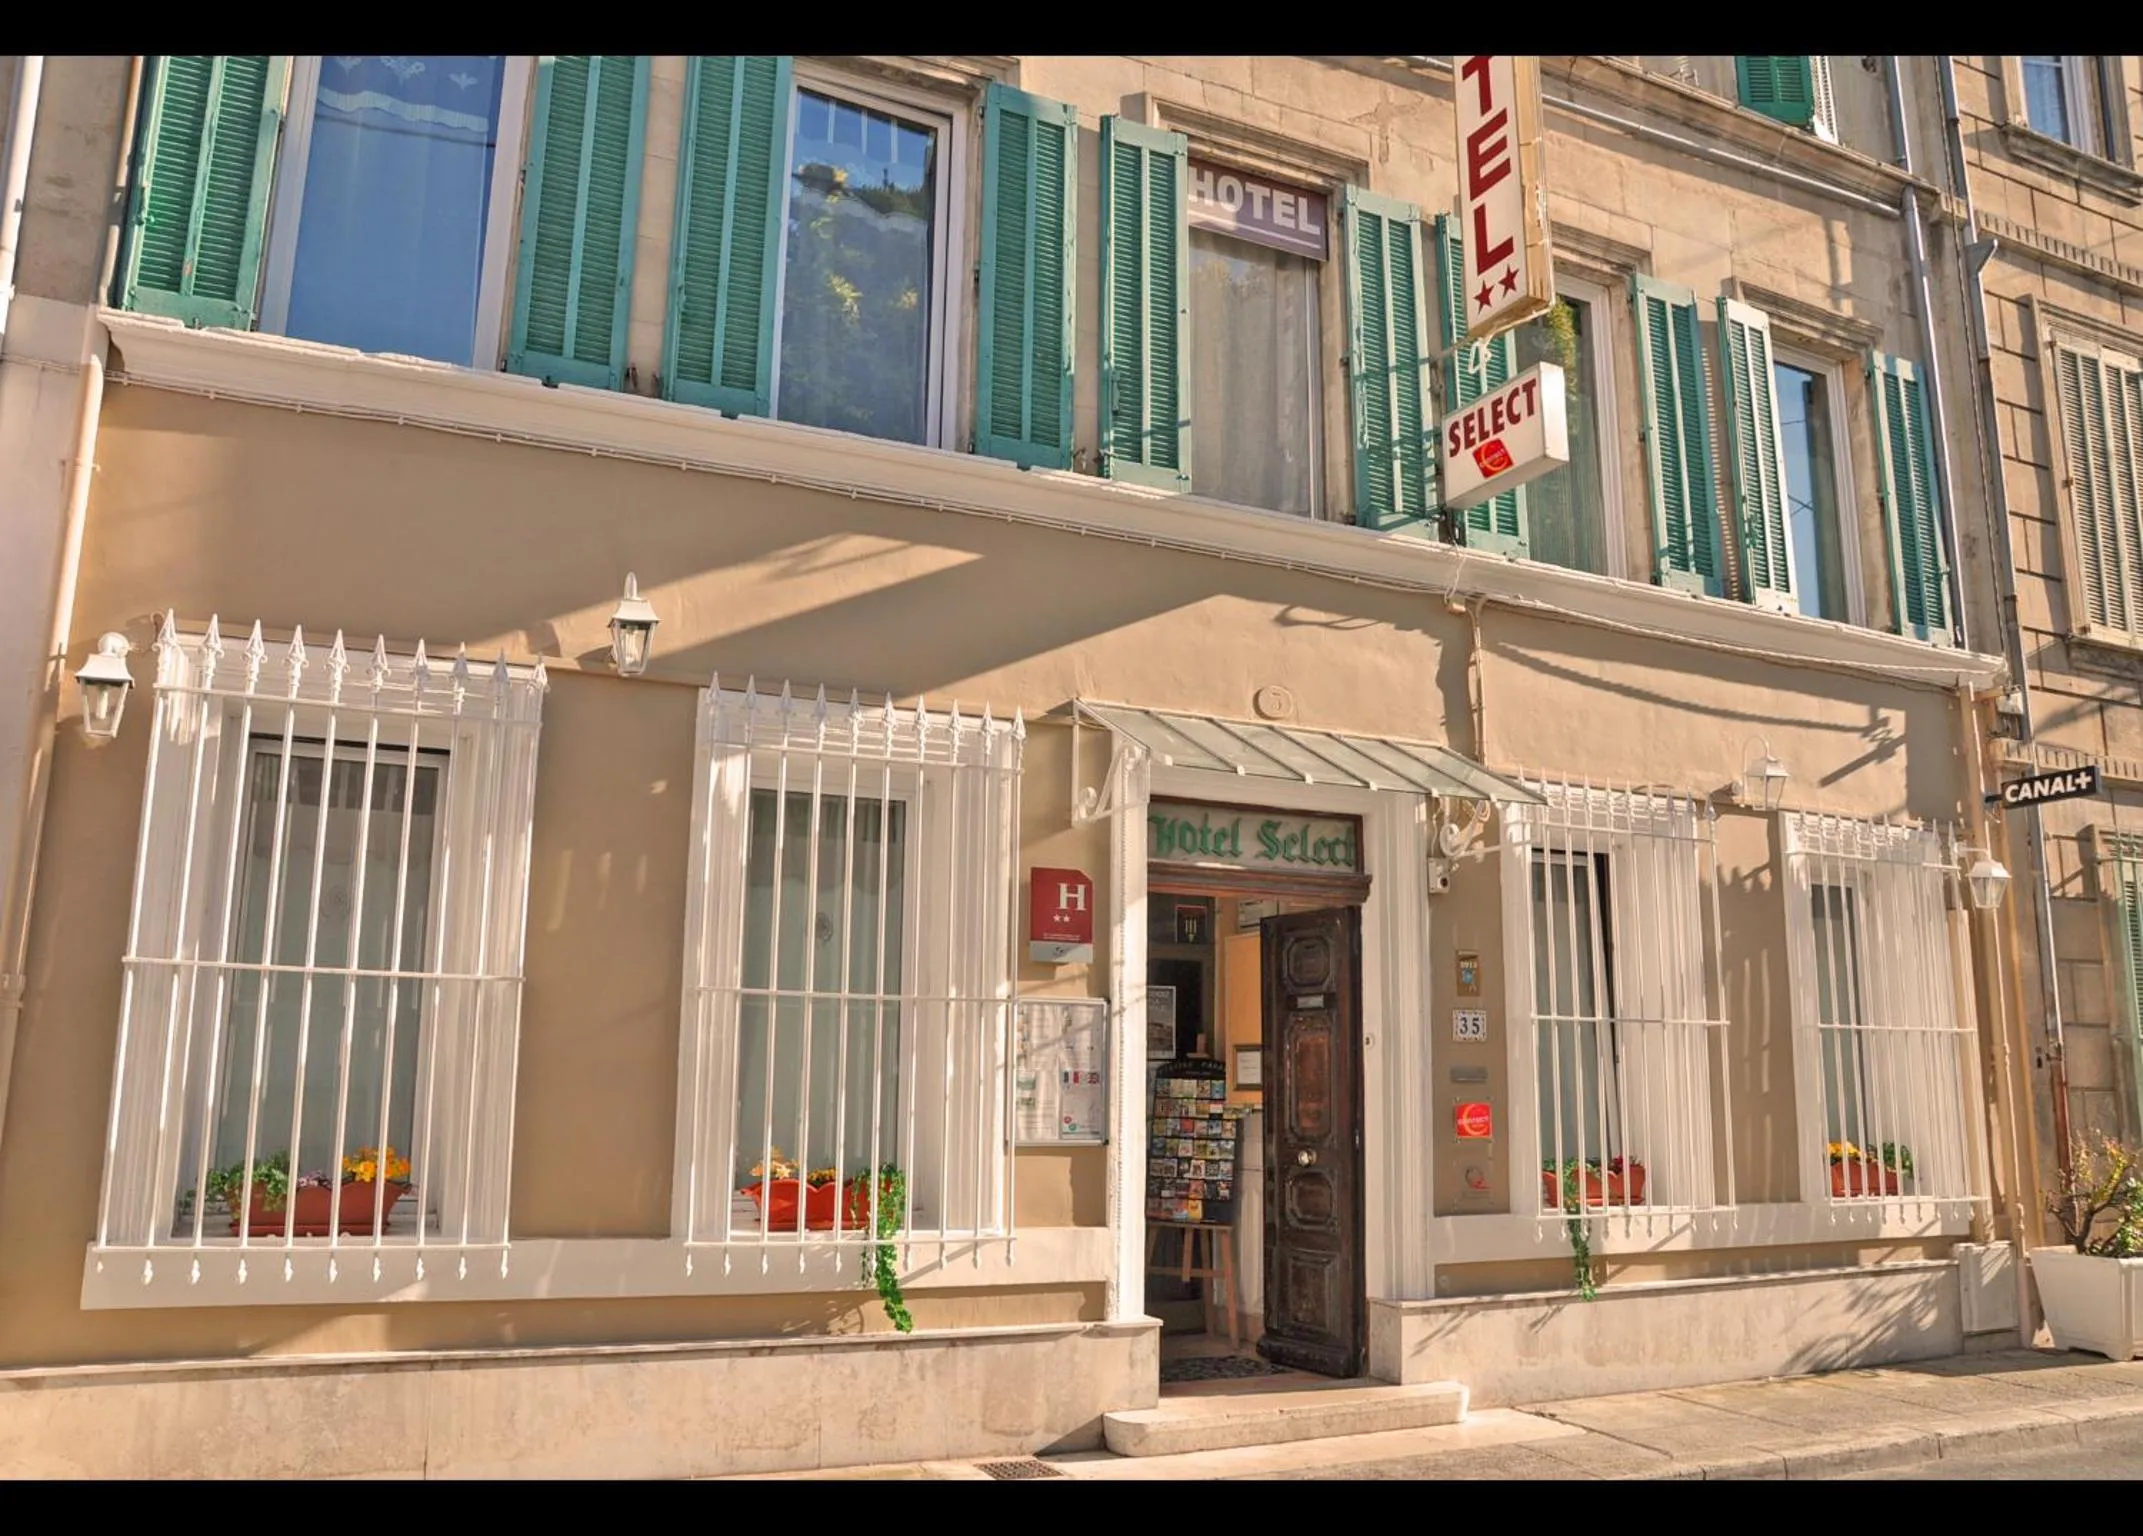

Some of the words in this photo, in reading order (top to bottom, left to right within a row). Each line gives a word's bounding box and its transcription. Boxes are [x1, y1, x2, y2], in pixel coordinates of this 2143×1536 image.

[1188, 166, 1320, 235] HOTEL
[1449, 378, 1537, 457] SELECT
[2005, 771, 2092, 803] CANAL+
[1148, 812, 1243, 858] Hotel
[1254, 819, 1357, 867] Select
[1057, 882, 1087, 911] H
[1459, 1016, 1481, 1035] 35
